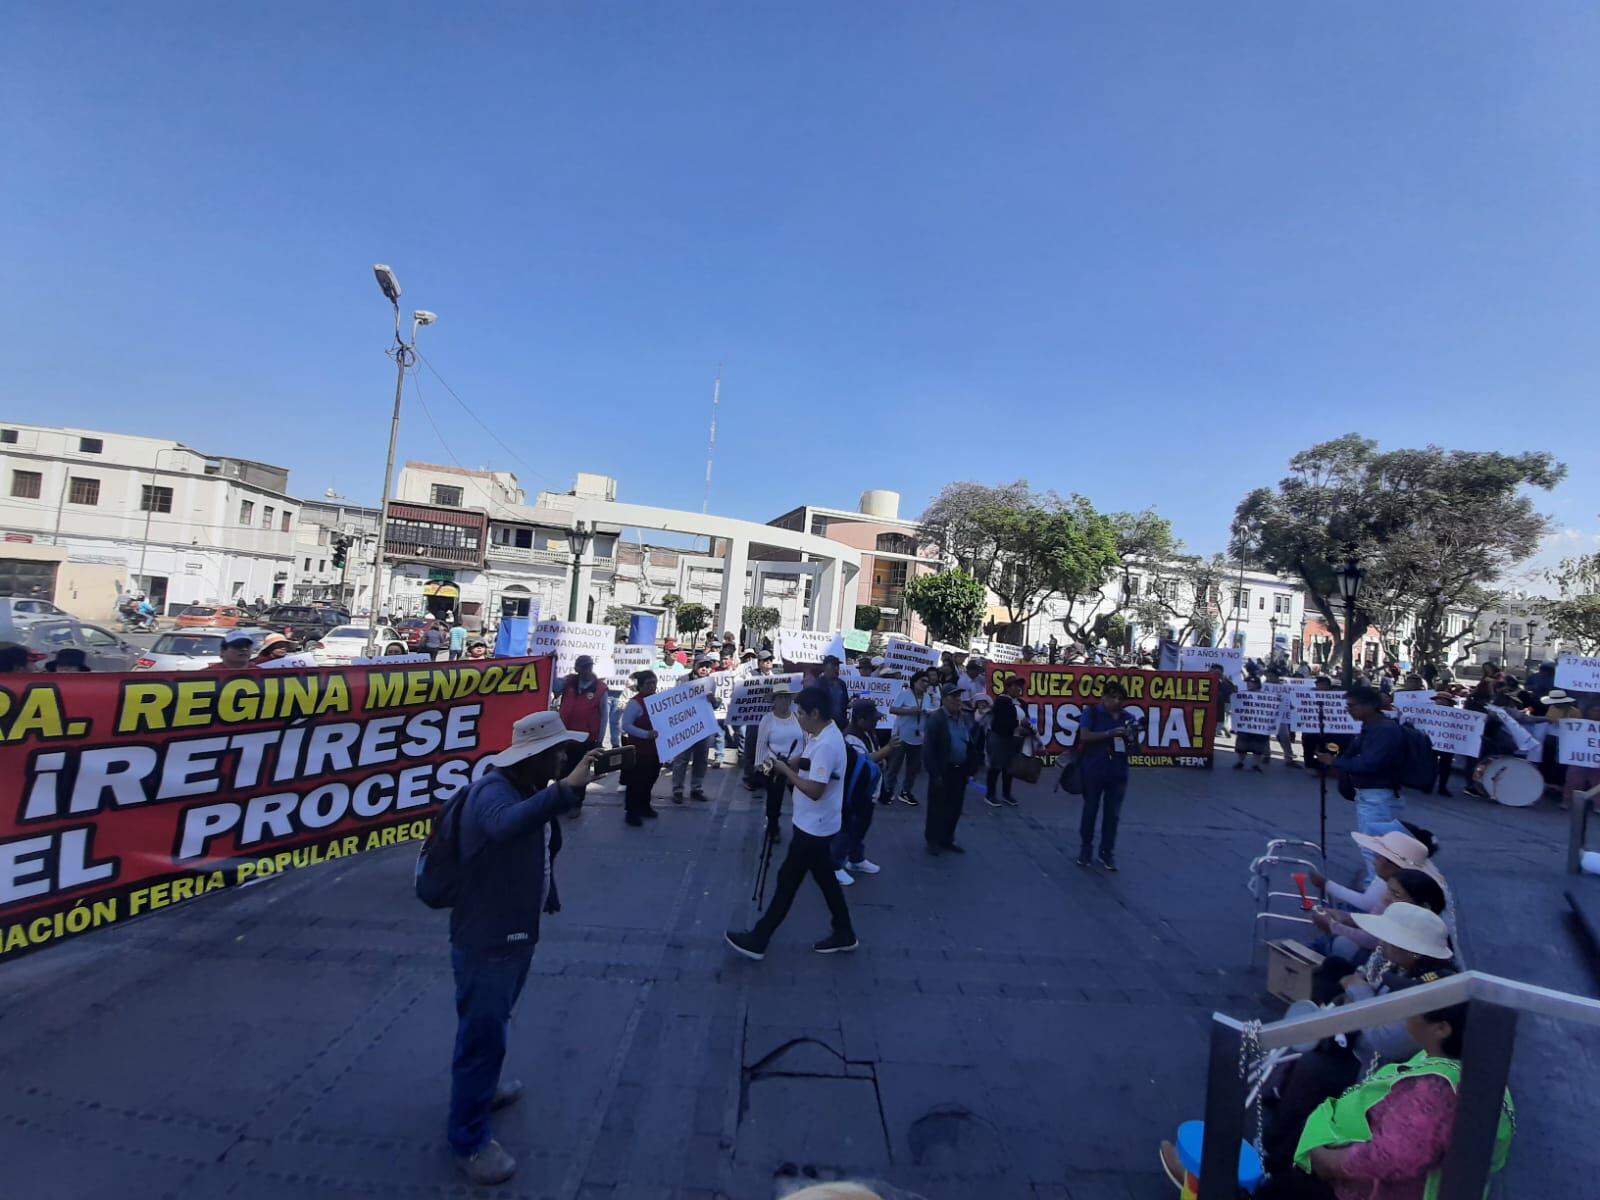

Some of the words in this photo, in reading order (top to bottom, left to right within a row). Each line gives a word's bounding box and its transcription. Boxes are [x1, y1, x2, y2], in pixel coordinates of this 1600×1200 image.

[536, 624, 602, 637] DEMANDADO
[536, 637, 607, 651] DEMANDANTE
[118, 674, 349, 732] REGINA
[365, 663, 538, 709] MENDOZA
[846, 680, 866, 690] JUAN
[868, 682, 892, 692] JORGE
[1028, 671, 1074, 697] JUEZ
[1151, 676, 1210, 701] CALLE
[651, 691, 688, 715] JUSTICIA
[688, 685, 705, 698] DRA
[668, 706, 697, 728] REGINA
[1402, 706, 1471, 721] DEMANDADO
[1473, 714, 1481, 722] Y
[667, 721, 705, 749] MENDOZA
[1437, 731, 1468, 742] JORGE
[24, 704, 481, 820] ¡RETÍRESE
[130, 871, 225, 916] FERIA
[236, 835, 359, 885] POPULAR
